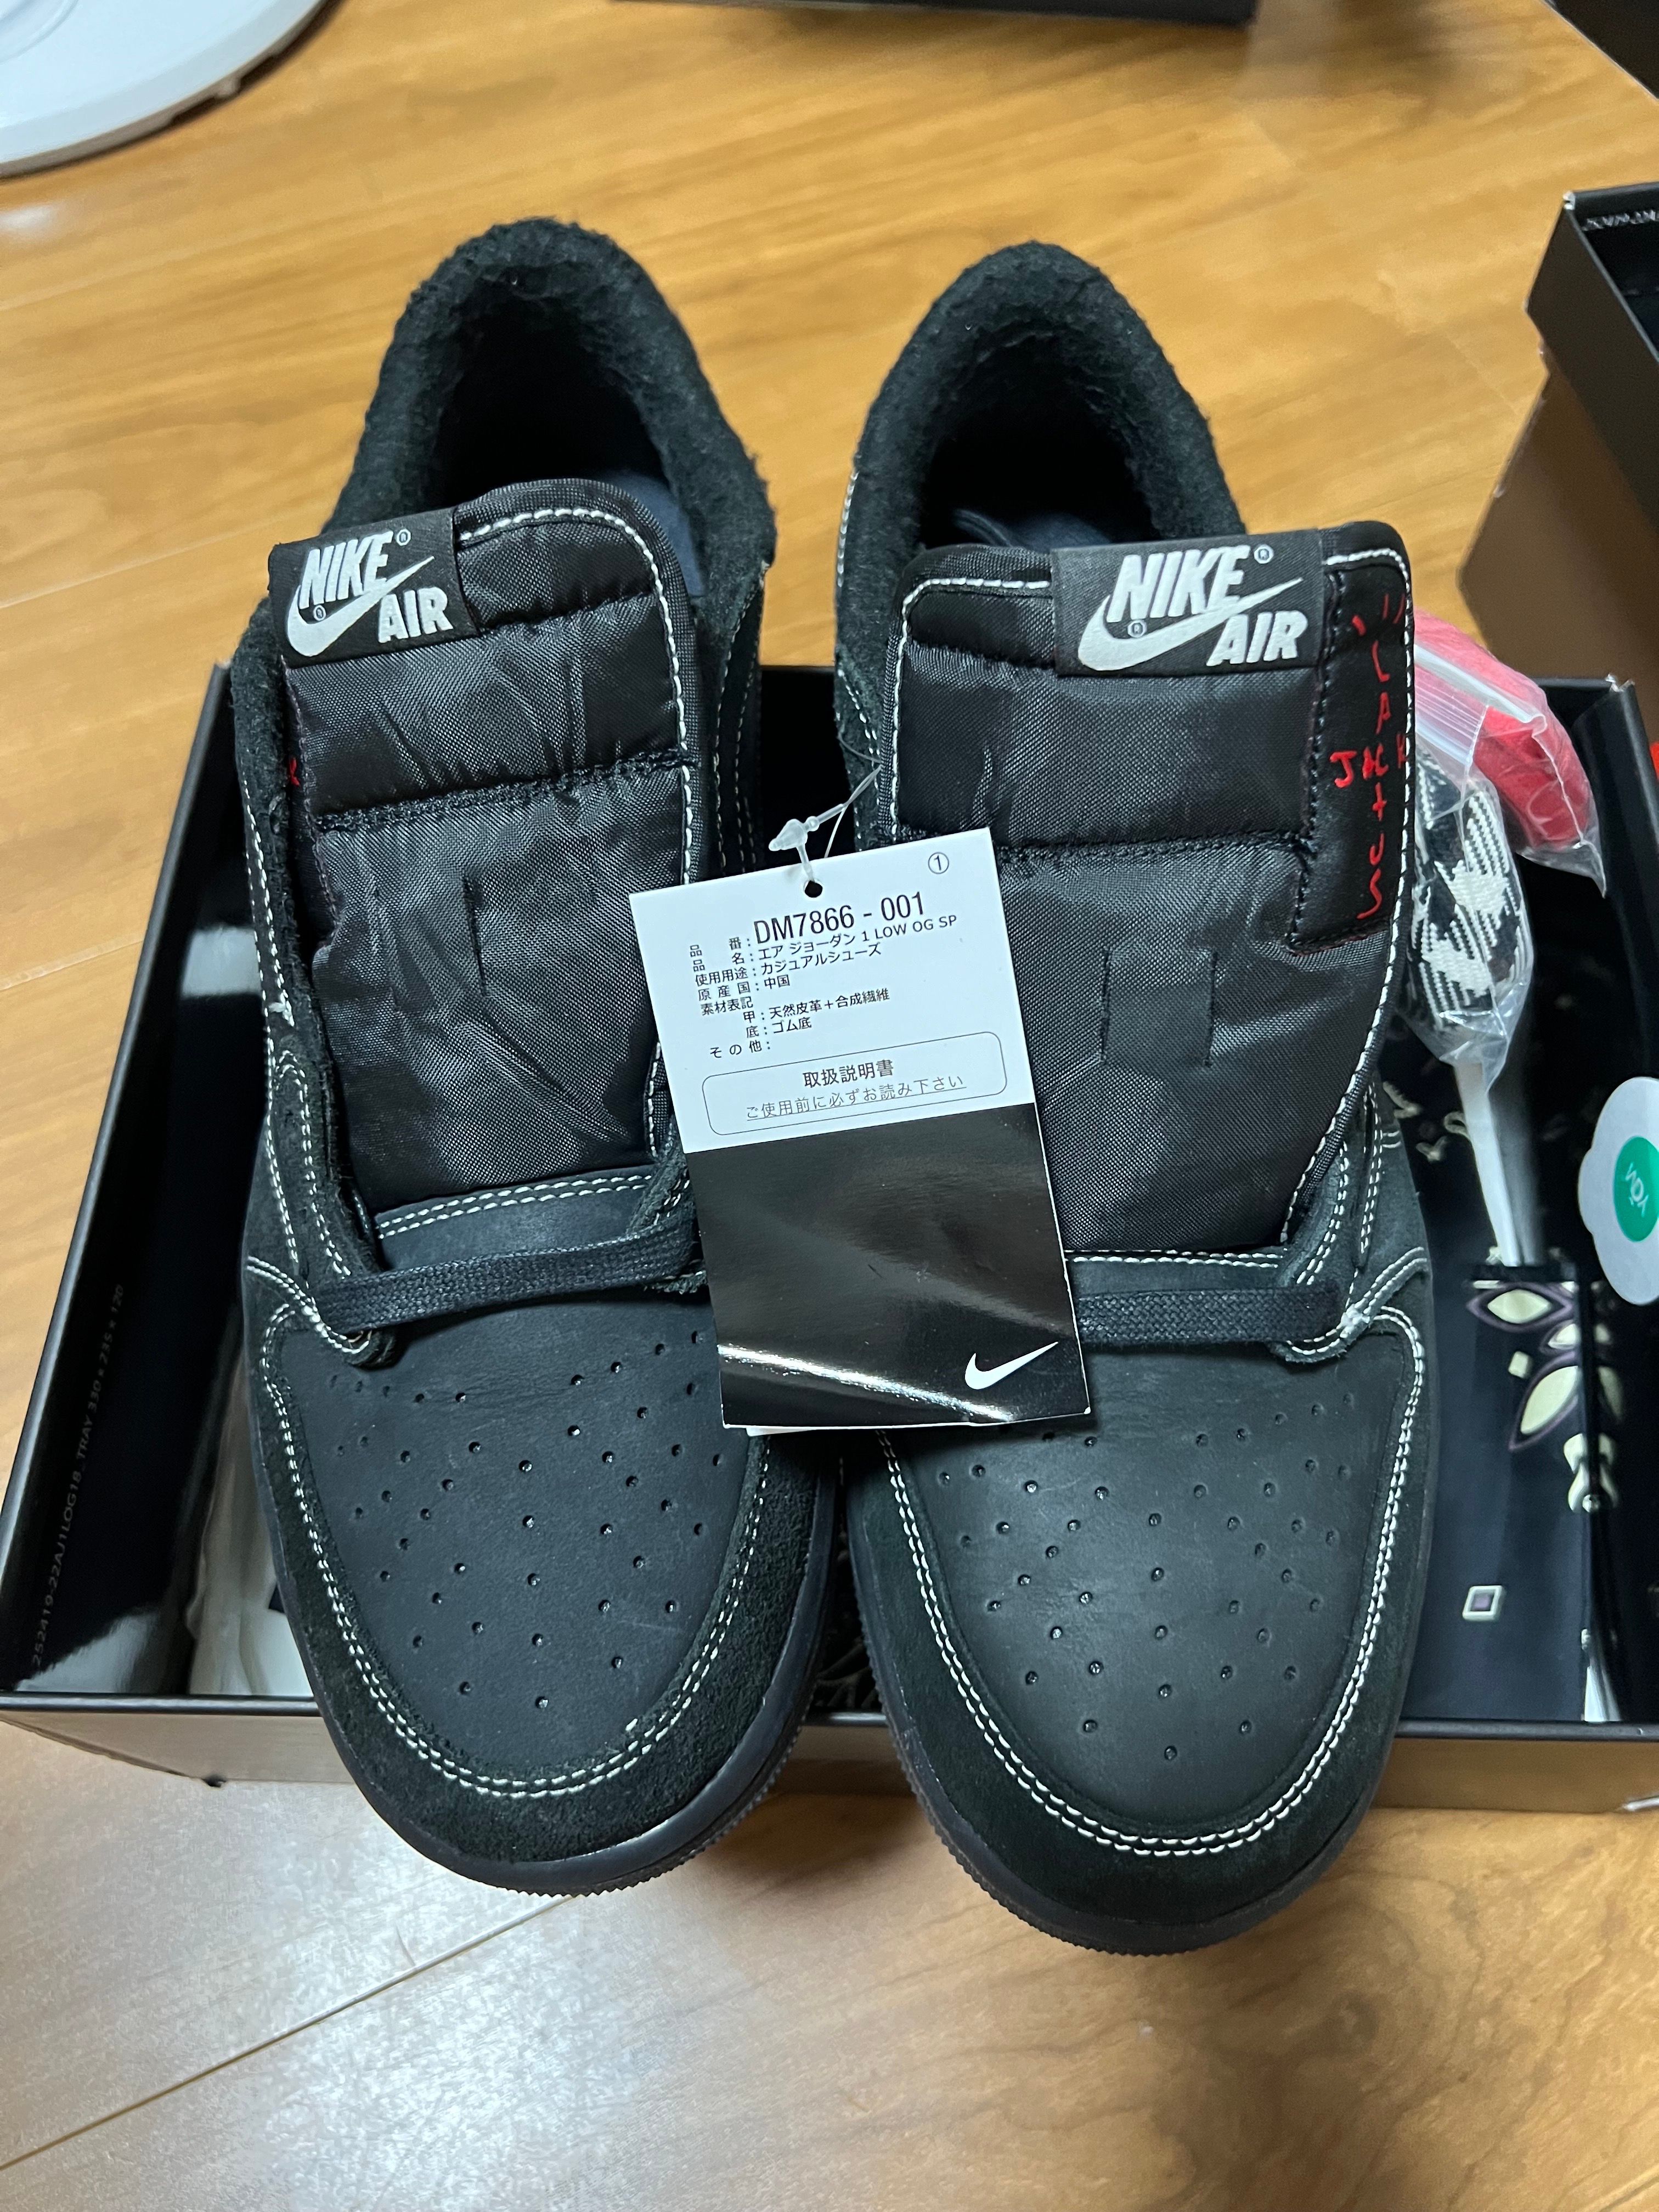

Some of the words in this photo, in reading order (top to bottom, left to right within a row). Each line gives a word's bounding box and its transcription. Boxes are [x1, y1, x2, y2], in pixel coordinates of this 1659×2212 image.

[298, 531, 393, 610] NIKE
[1107, 545, 1250, 622] NIKE
[378, 586, 454, 643] AIR
[1206, 610, 1308, 666] AIR
[862, 930, 870, 941] 1
[875, 923, 906, 939] LOW
[912, 919, 933, 932] OG
[939, 915, 956, 928] SP
[701, 996, 753, 1015] 素材表記
[772, 1017, 811, 1034] ゴム底
[803, 1059, 893, 1088] 取扱説明書
[746, 1076, 966, 1121] ご使用前に必ずお読み下さい
